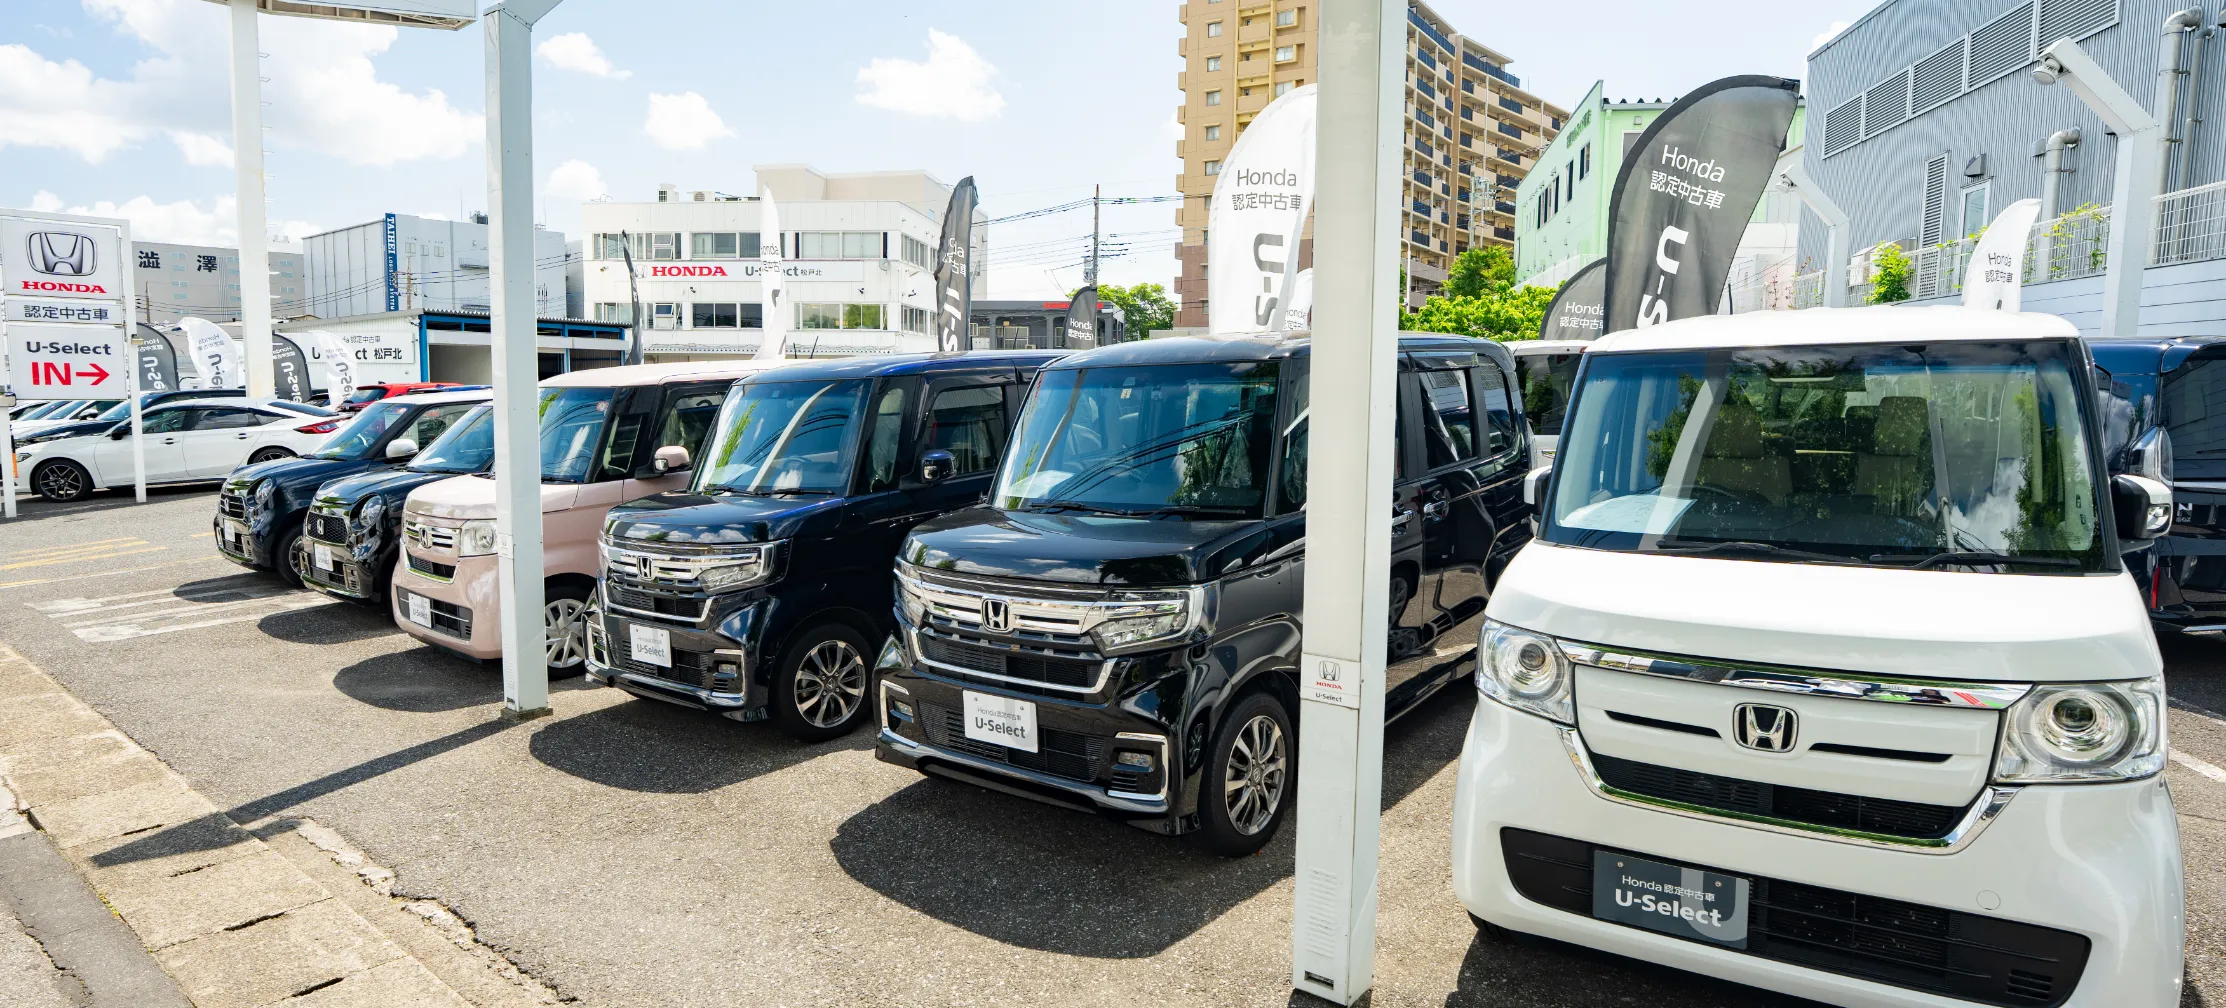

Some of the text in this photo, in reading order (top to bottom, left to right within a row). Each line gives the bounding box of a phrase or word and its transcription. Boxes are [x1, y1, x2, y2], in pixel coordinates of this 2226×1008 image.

[1662, 144, 1725, 183] Honda
[1236, 168, 1297, 187] Honda
[1650, 170, 1725, 209] 認定中古車
[1231, 191, 1301, 211] 認定中古車
[387, 217, 395, 254] TAIHEI
[651, 266, 728, 276] HONDA
[22, 280, 107, 293] HONDA
[24, 304, 109, 320] 認定中古車
[26, 341, 112, 355] U-Select
[374, 347, 402, 360] 松戸北
[31, 361, 72, 385] IN
[636, 643, 665, 658] U-Select
[1316, 681, 1342, 690] HONDA
[1315, 692, 1343, 702] U-Select
[975, 716, 1026, 739] U-Select
[1621, 874, 1716, 903] Honda 認定中古車
[1615, 888, 1722, 928] U-Select
